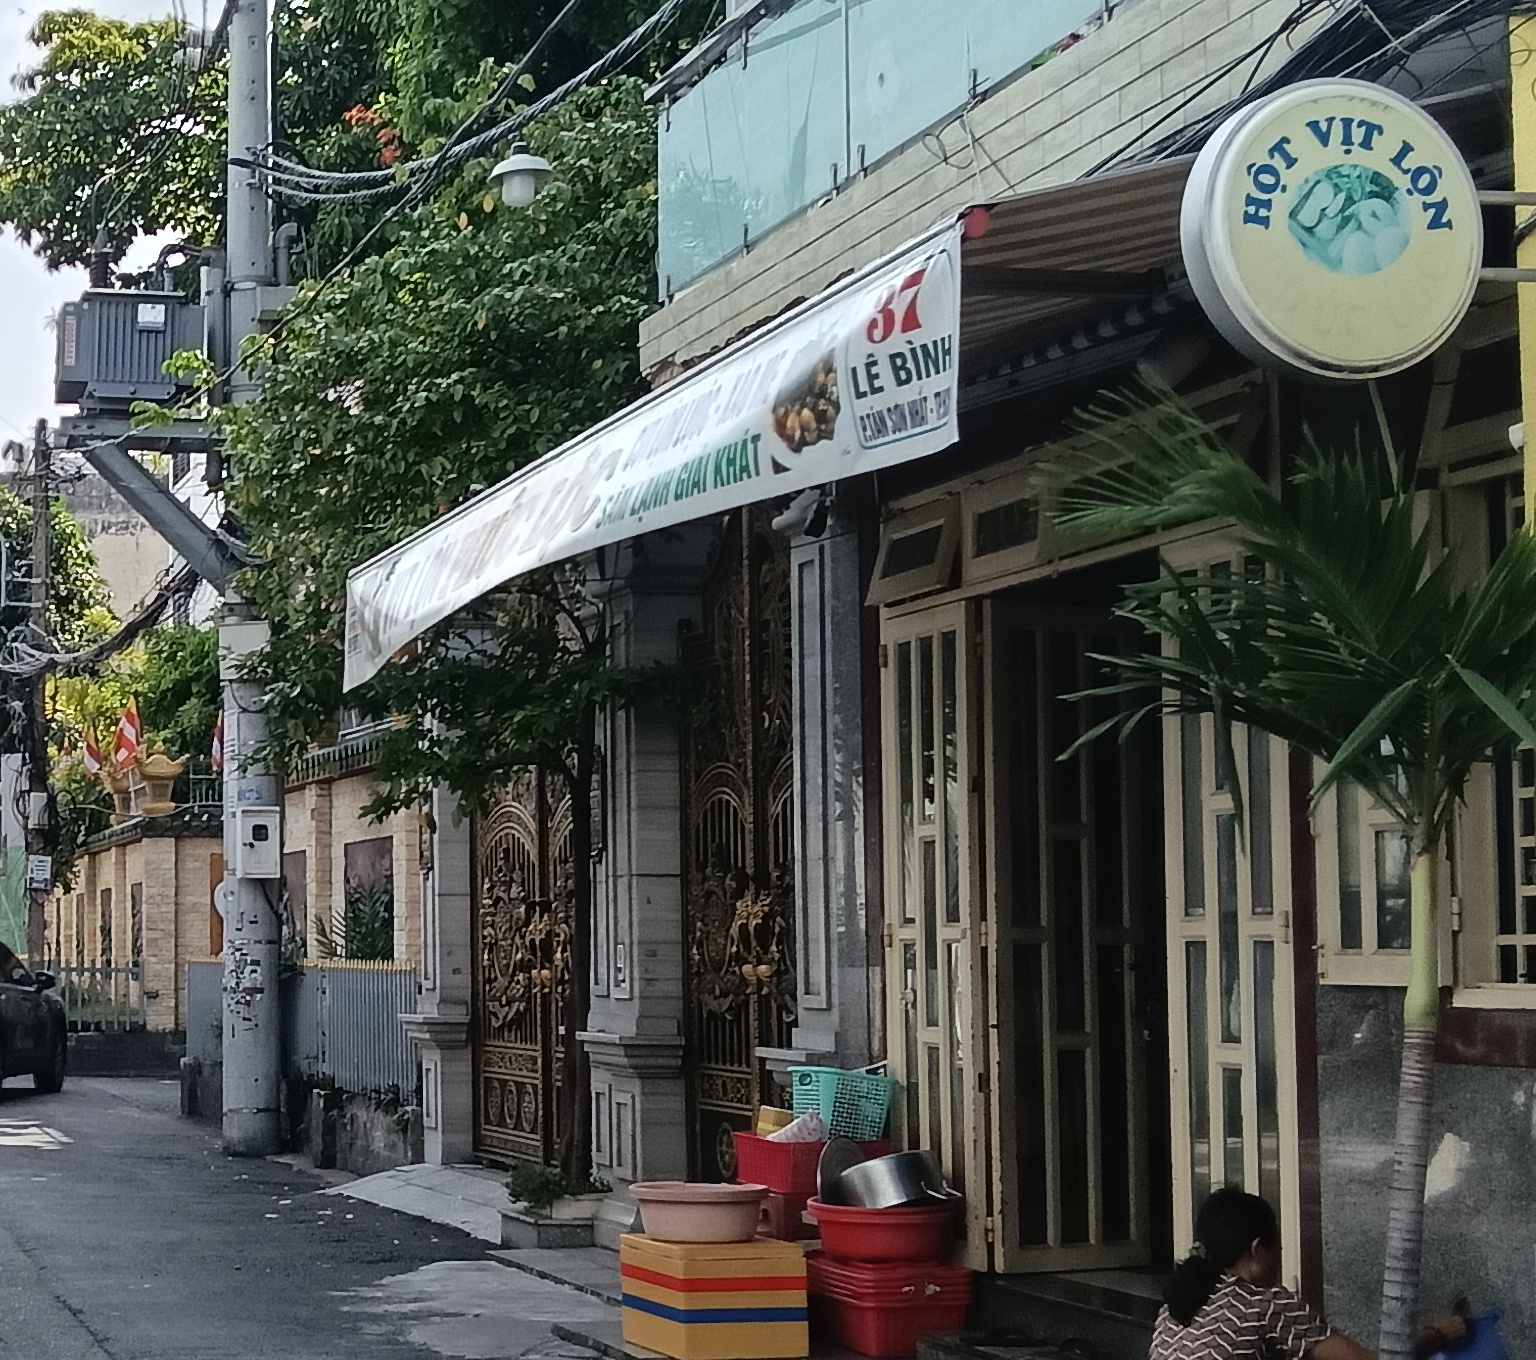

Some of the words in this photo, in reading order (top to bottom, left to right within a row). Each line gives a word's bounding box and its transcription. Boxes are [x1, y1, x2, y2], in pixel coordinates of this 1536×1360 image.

[1243, 137, 1298, 230] HỘT
[1306, 117, 1384, 155] VỊT
[1389, 140, 1454, 232] LỘN
[867, 267, 928, 344] 37
[851, 353, 885, 400] LÊ
[889, 333, 953, 387] BÌNH
[713, 428, 762, 489] KHÁT
